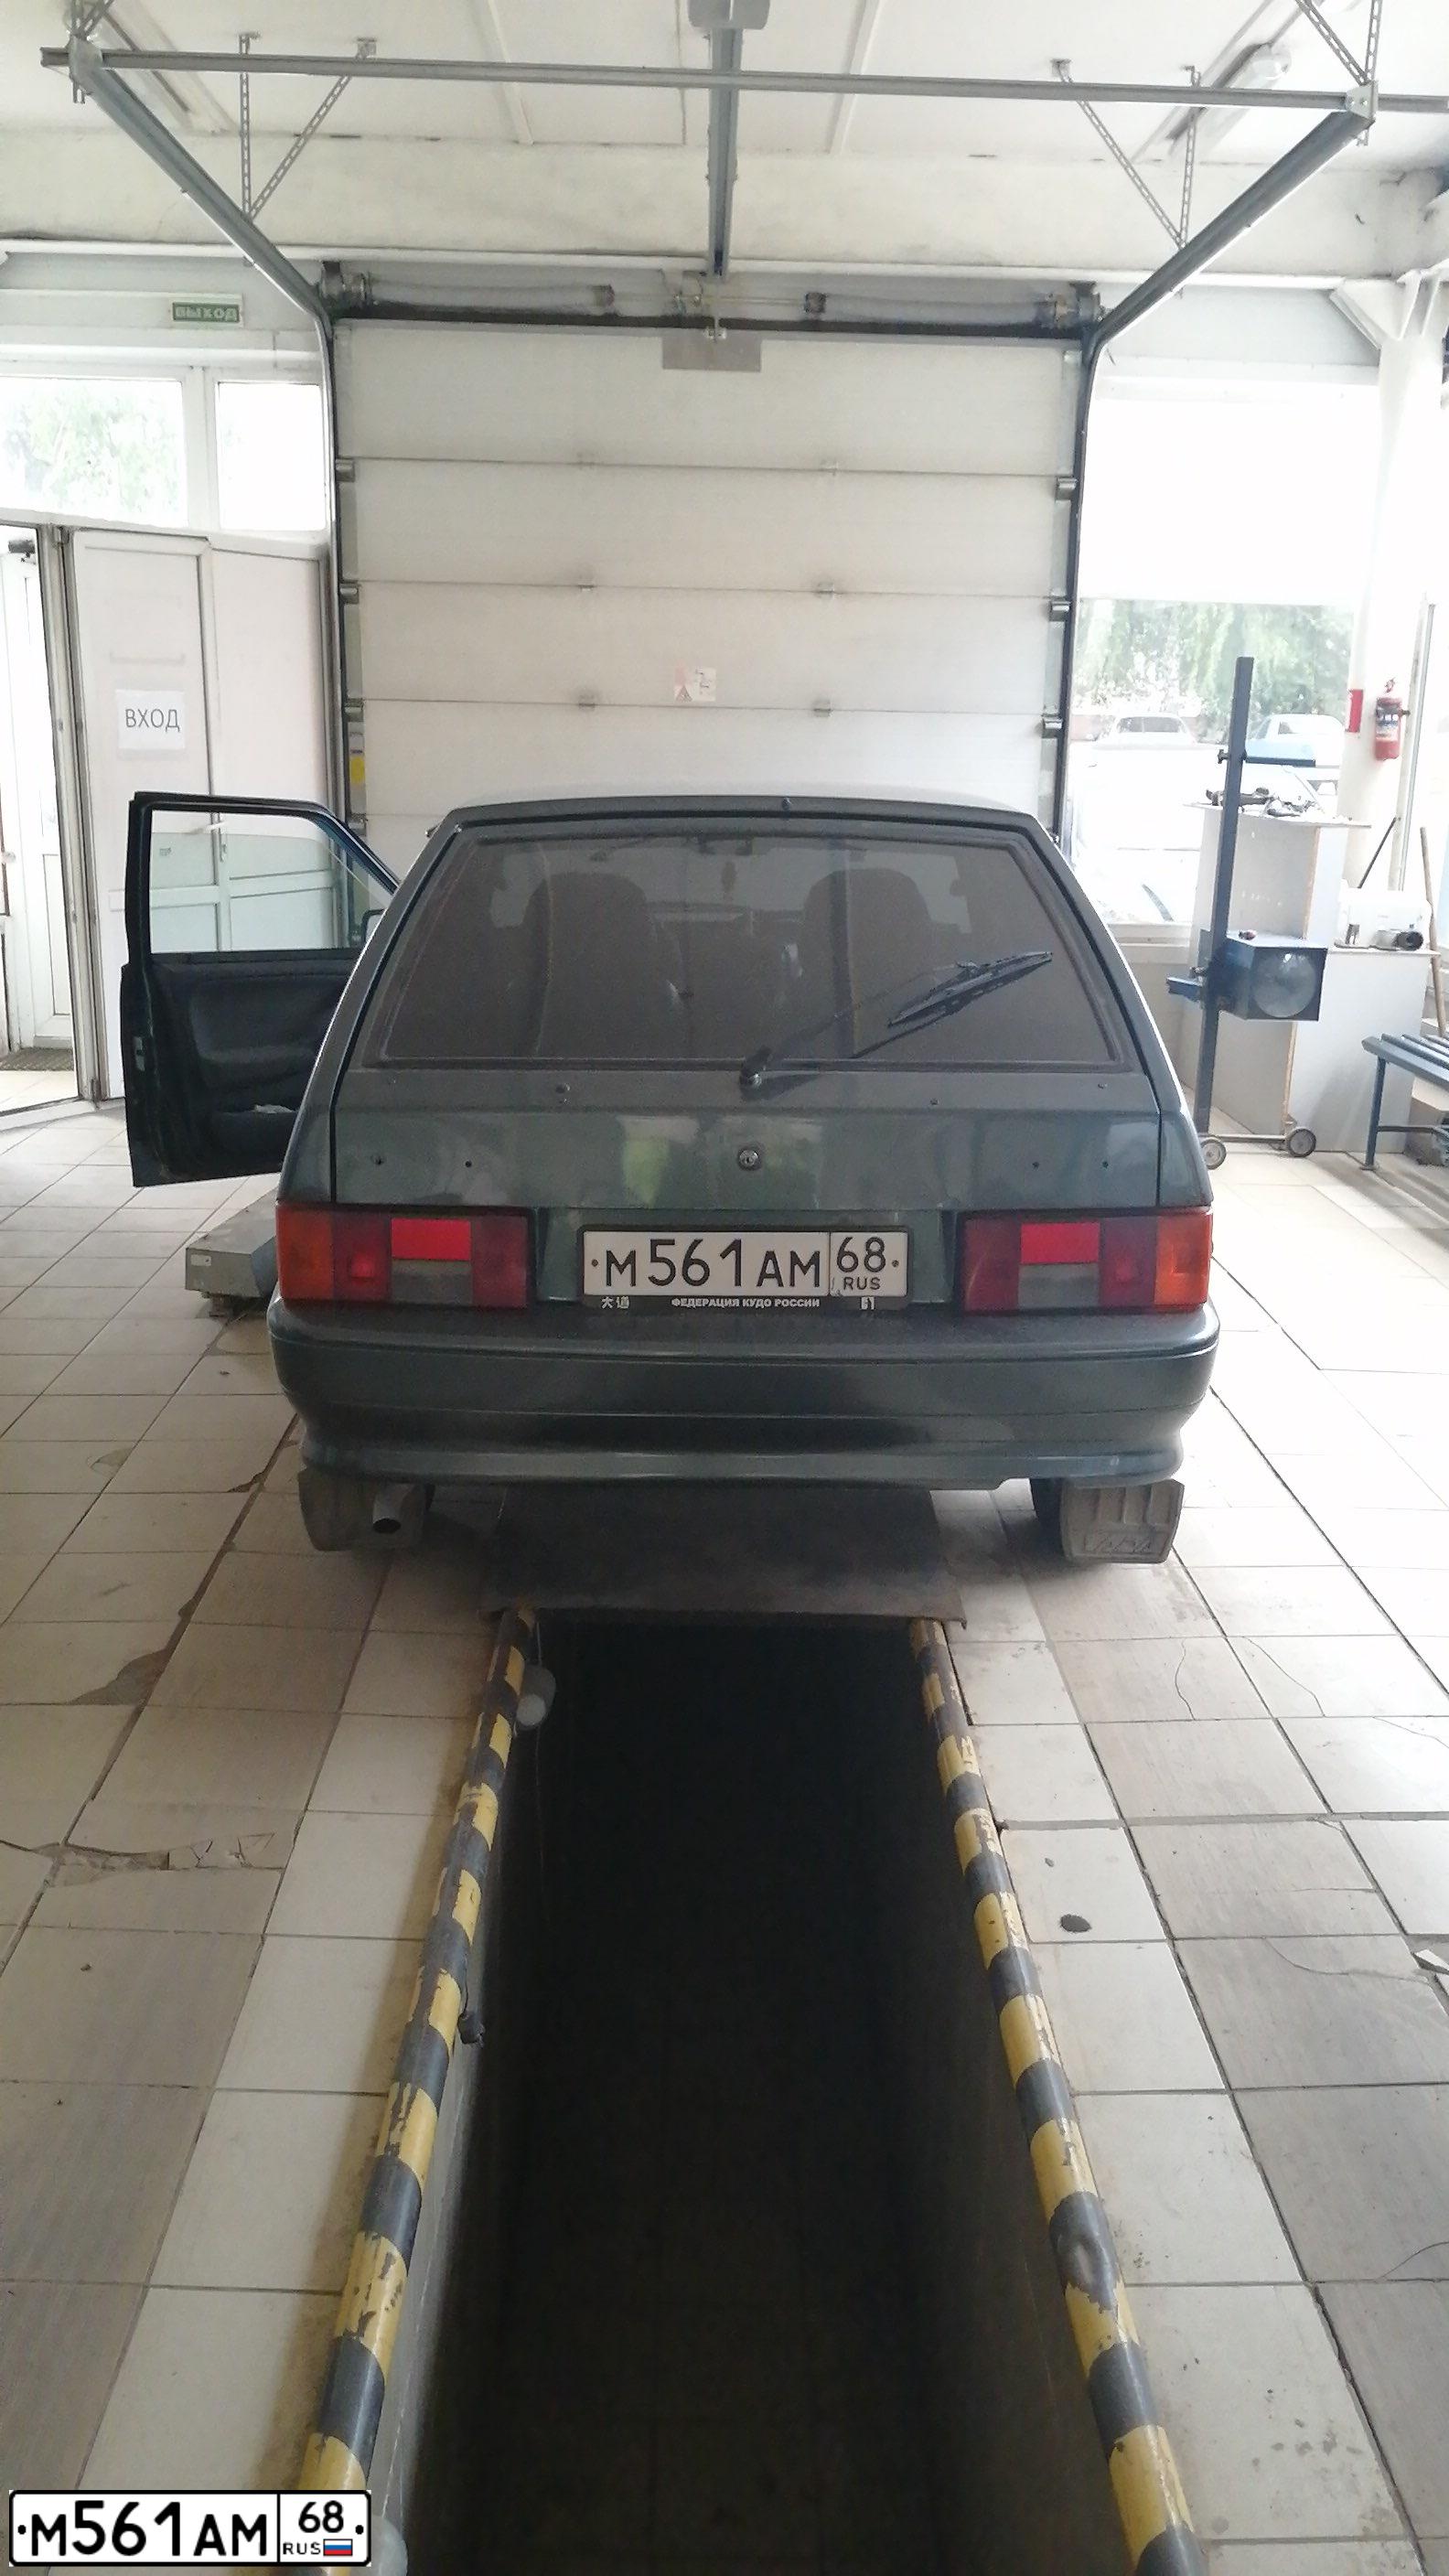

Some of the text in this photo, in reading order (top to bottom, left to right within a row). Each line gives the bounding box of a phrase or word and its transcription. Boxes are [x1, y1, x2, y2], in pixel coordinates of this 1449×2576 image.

[124, 708, 180, 732] ВХОД
[836, 1237, 886, 1272] 68
[843, 1276, 881, 1290] RUS
[671, 1298, 821, 1308] ФЕДЕРАЦИЯ КУДО РОССИИ
